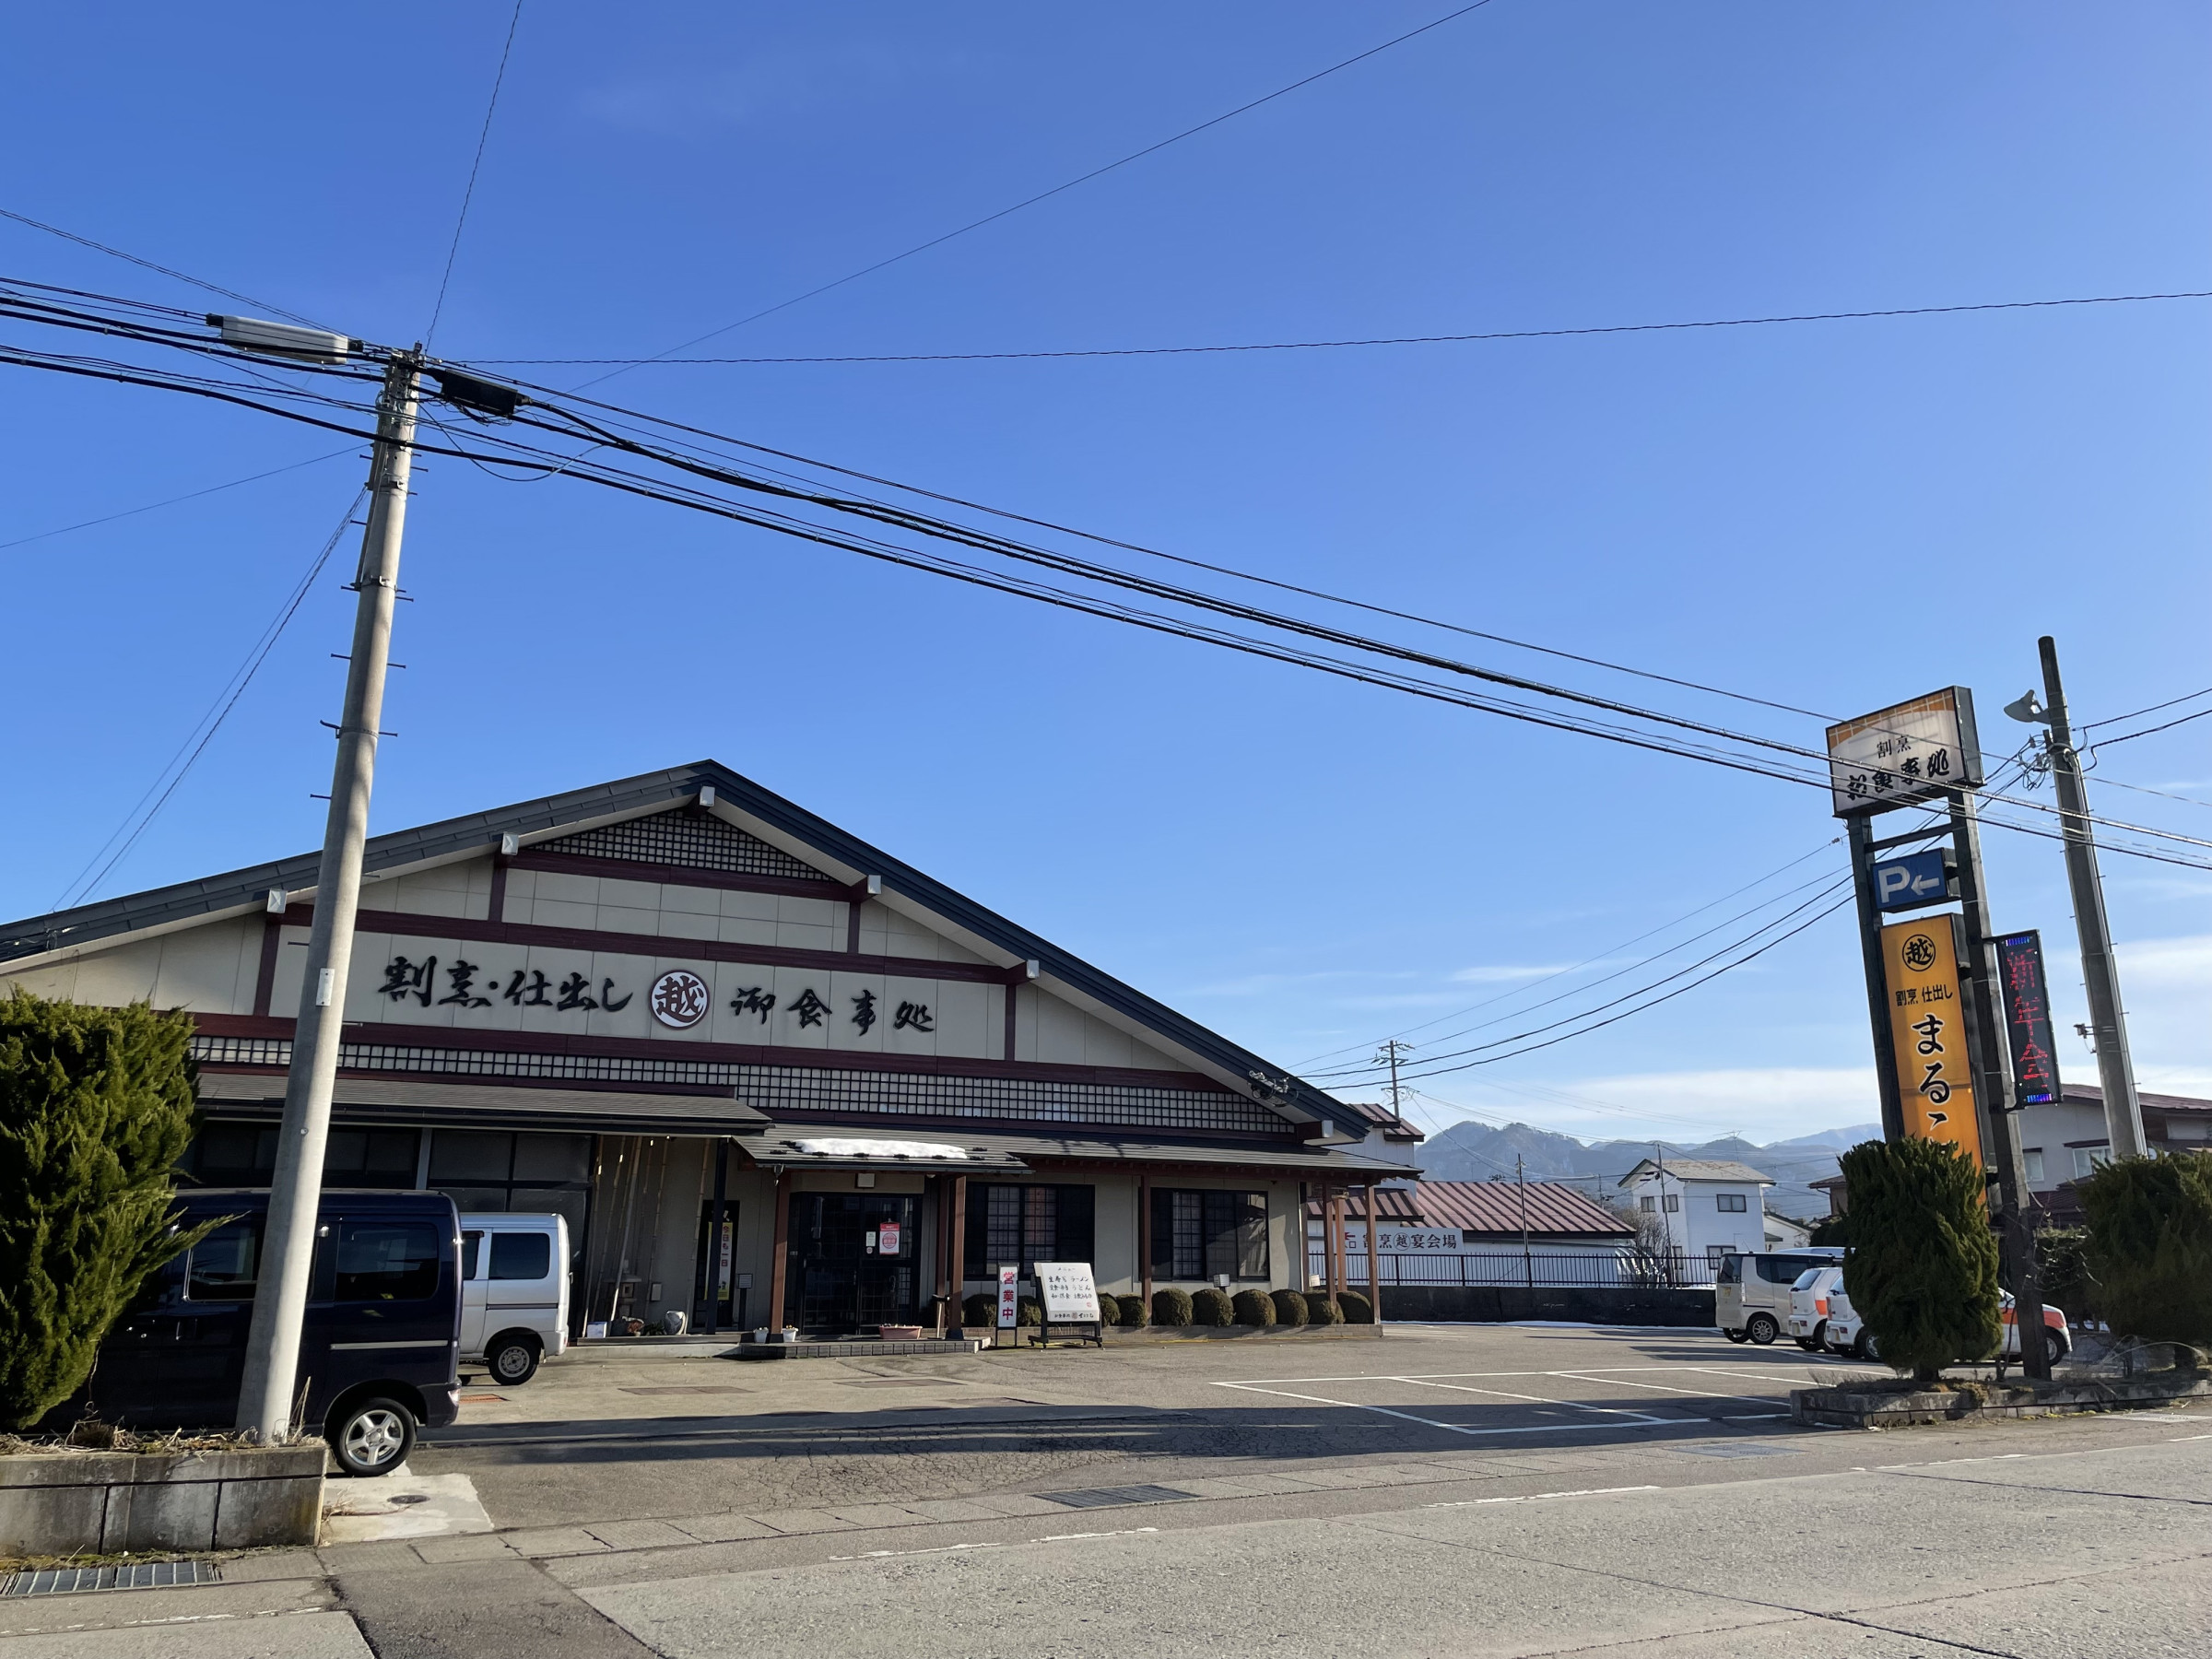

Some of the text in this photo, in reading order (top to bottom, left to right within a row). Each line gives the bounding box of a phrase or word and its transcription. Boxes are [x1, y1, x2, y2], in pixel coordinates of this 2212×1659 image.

[1877, 736, 1911, 759] 割烹
[1878, 866, 1910, 902] P
[731, 987, 934, 1036] 御食事処
[1896, 983, 1953, 1006] 割烹 仕出し
[1003, 1272, 1015, 1320] 営業中
